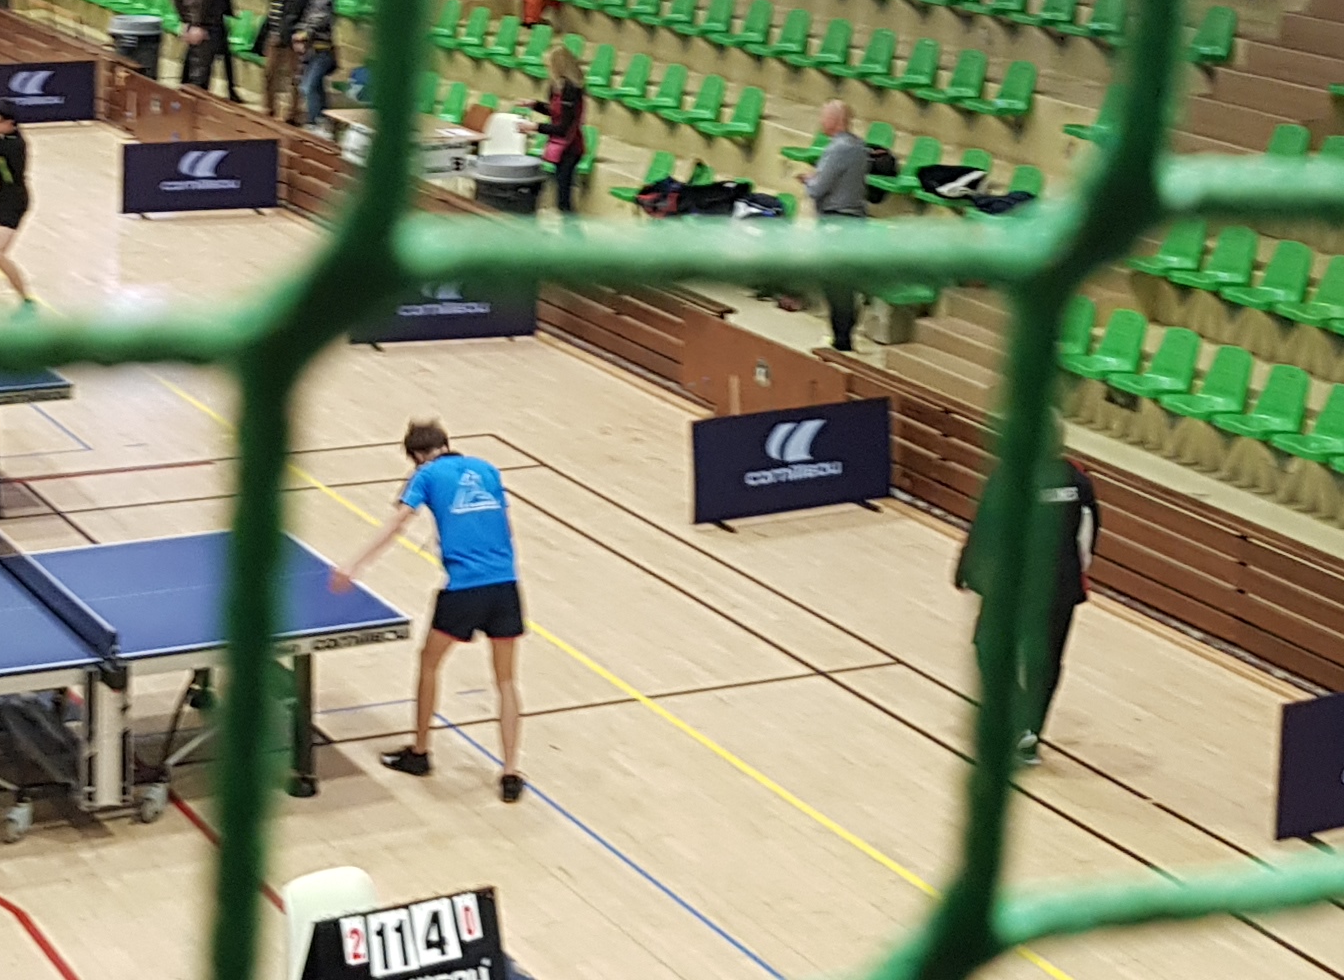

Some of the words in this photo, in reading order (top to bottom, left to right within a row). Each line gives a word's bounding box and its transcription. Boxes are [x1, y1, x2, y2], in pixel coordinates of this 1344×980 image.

[346, 927, 367, 960] 2
[375, 918, 409, 970] 11
[425, 909, 448, 956] 4
